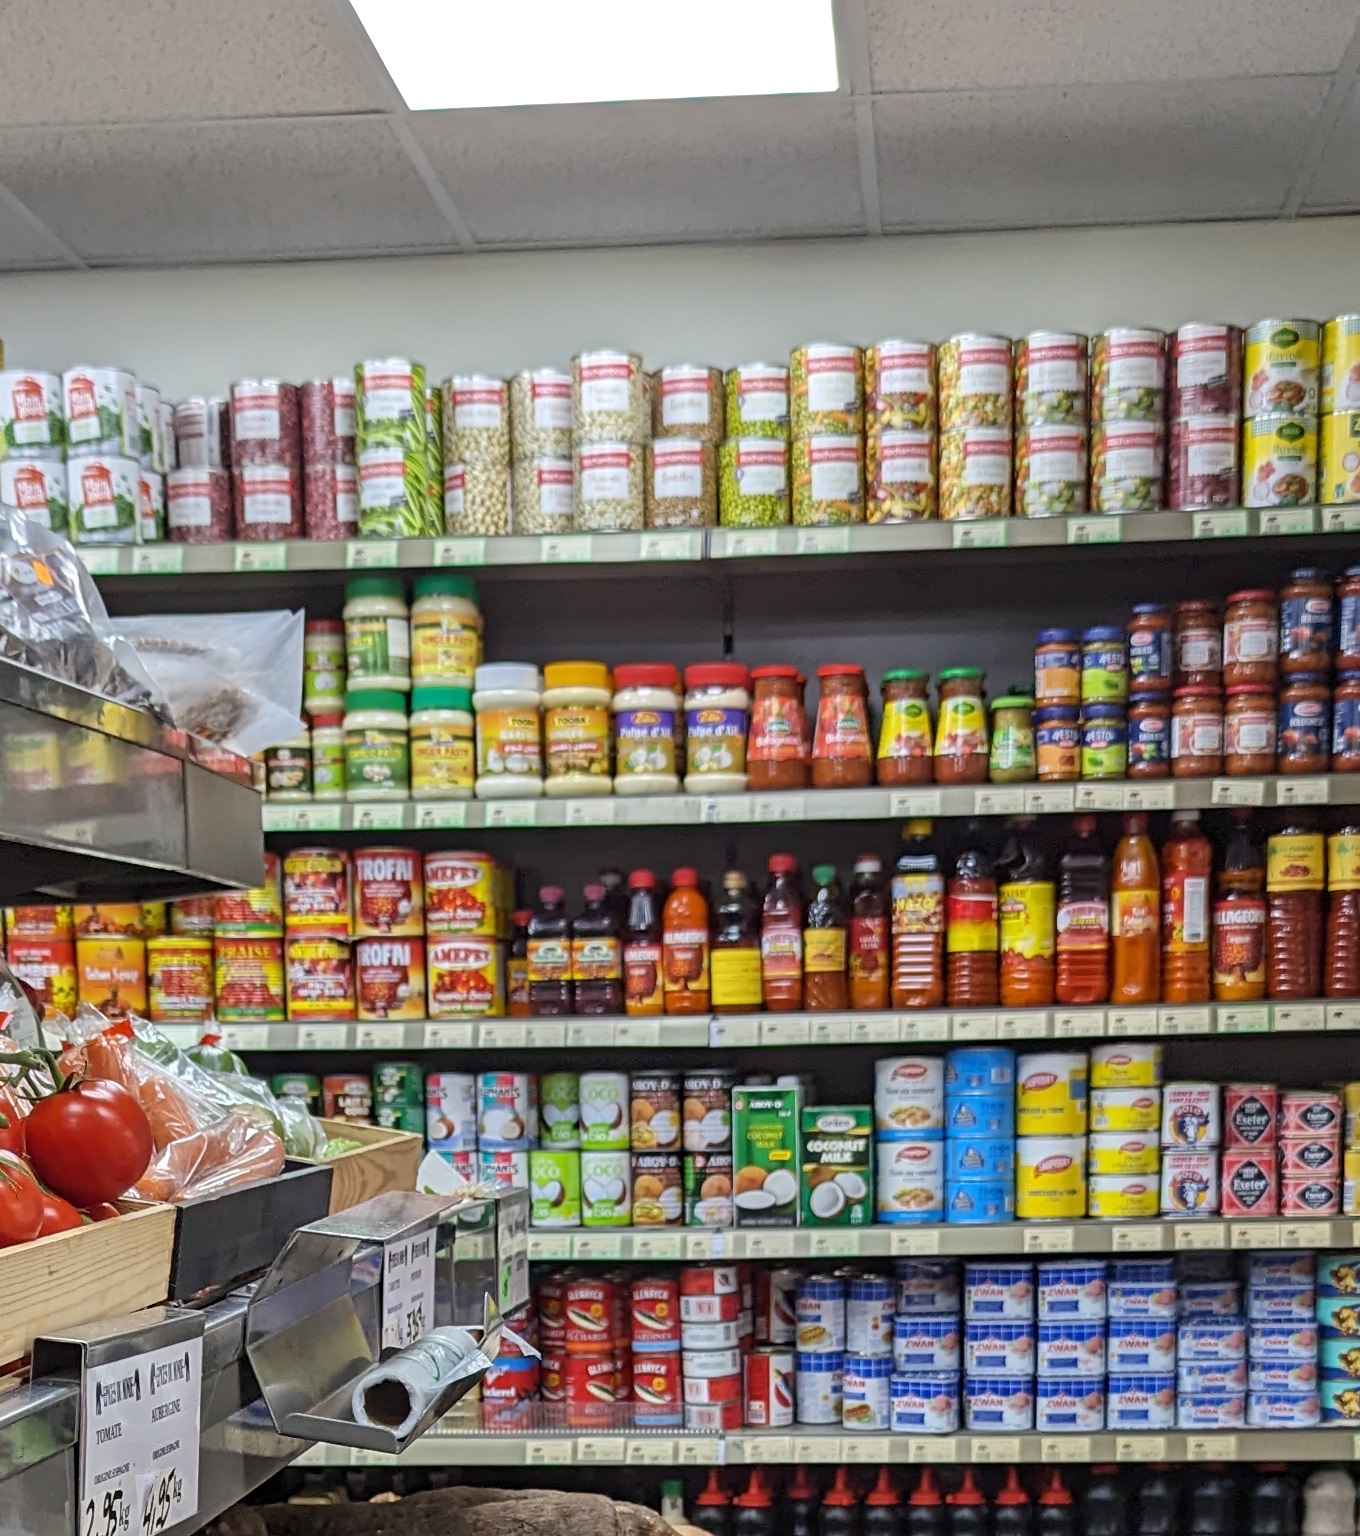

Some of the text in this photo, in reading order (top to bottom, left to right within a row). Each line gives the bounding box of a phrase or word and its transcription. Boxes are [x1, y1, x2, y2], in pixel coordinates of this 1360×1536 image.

[356, 858, 413, 881] TROFAI
[218, 946, 270, 959] PRAISE
[1236, 1113, 1269, 1126] Exeter
[1306, 1112, 1329, 1121] Exeter
[807, 1138, 866, 1152] COCONUT
[820, 1152, 854, 1164] MILK
[1304, 1150, 1326, 1160] Exeter
[707, 1156, 731, 1167] ARO
[531, 1163, 561, 1180] OCO
[1234, 1179, 1266, 1191] Exeter
[1304, 1192, 1327, 1200] Exeter
[972, 1288, 1004, 1297] ZWAN
[1047, 1288, 1078, 1297] ZWAN
[904, 1340, 935, 1349] ZWAN
[975, 1343, 1006, 1352] ZWAN
[1047, 1343, 1078, 1352] ZWAN
[1118, 1339, 1149, 1349] ZWAN
[895, 1400, 925, 1409] ZWAN
[972, 1398, 1003, 1407] ZWAN
[1046, 1399, 1077, 1408] ZWAN
[1118, 1395, 1149, 1405] ZWAN
[151, 1399, 181, 1423] AUBERGINE
[96, 1423, 122, 1445] TOMATE
[173, 1476, 183, 1503] kg
[119, 1501, 130, 1531] kg
